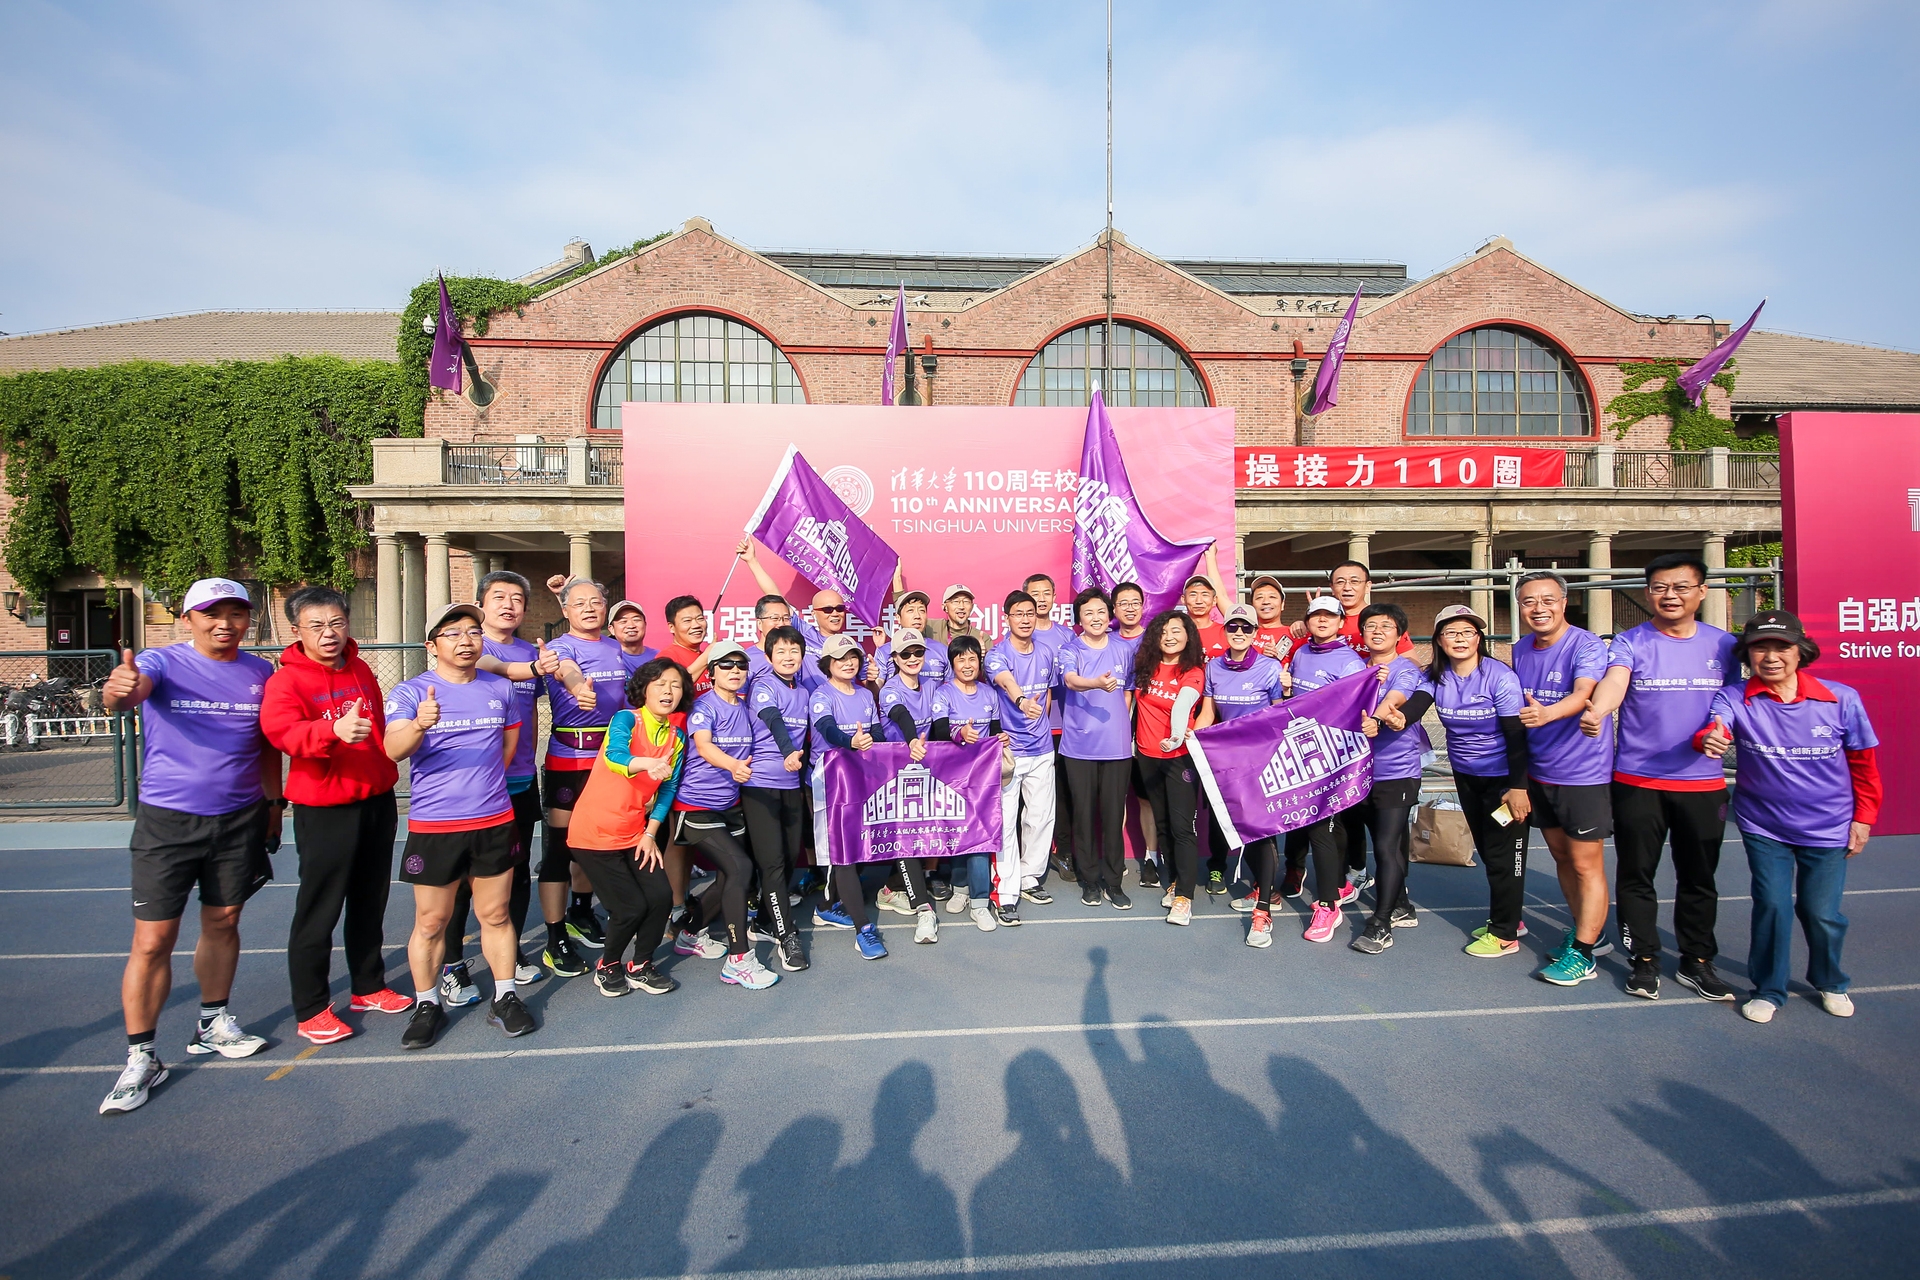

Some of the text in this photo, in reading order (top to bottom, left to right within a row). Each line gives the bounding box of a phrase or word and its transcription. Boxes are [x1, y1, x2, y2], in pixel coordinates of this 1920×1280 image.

[890, 496, 938, 513] 110th
[892, 518, 987, 533] TSINGHUA
[786, 550, 813, 573] 2020
[1839, 642, 1892, 658] Strive
[1281, 805, 1319, 825] 2020
[871, 842, 901, 855] 2020
[1514, 851, 1522, 877] YEARS
